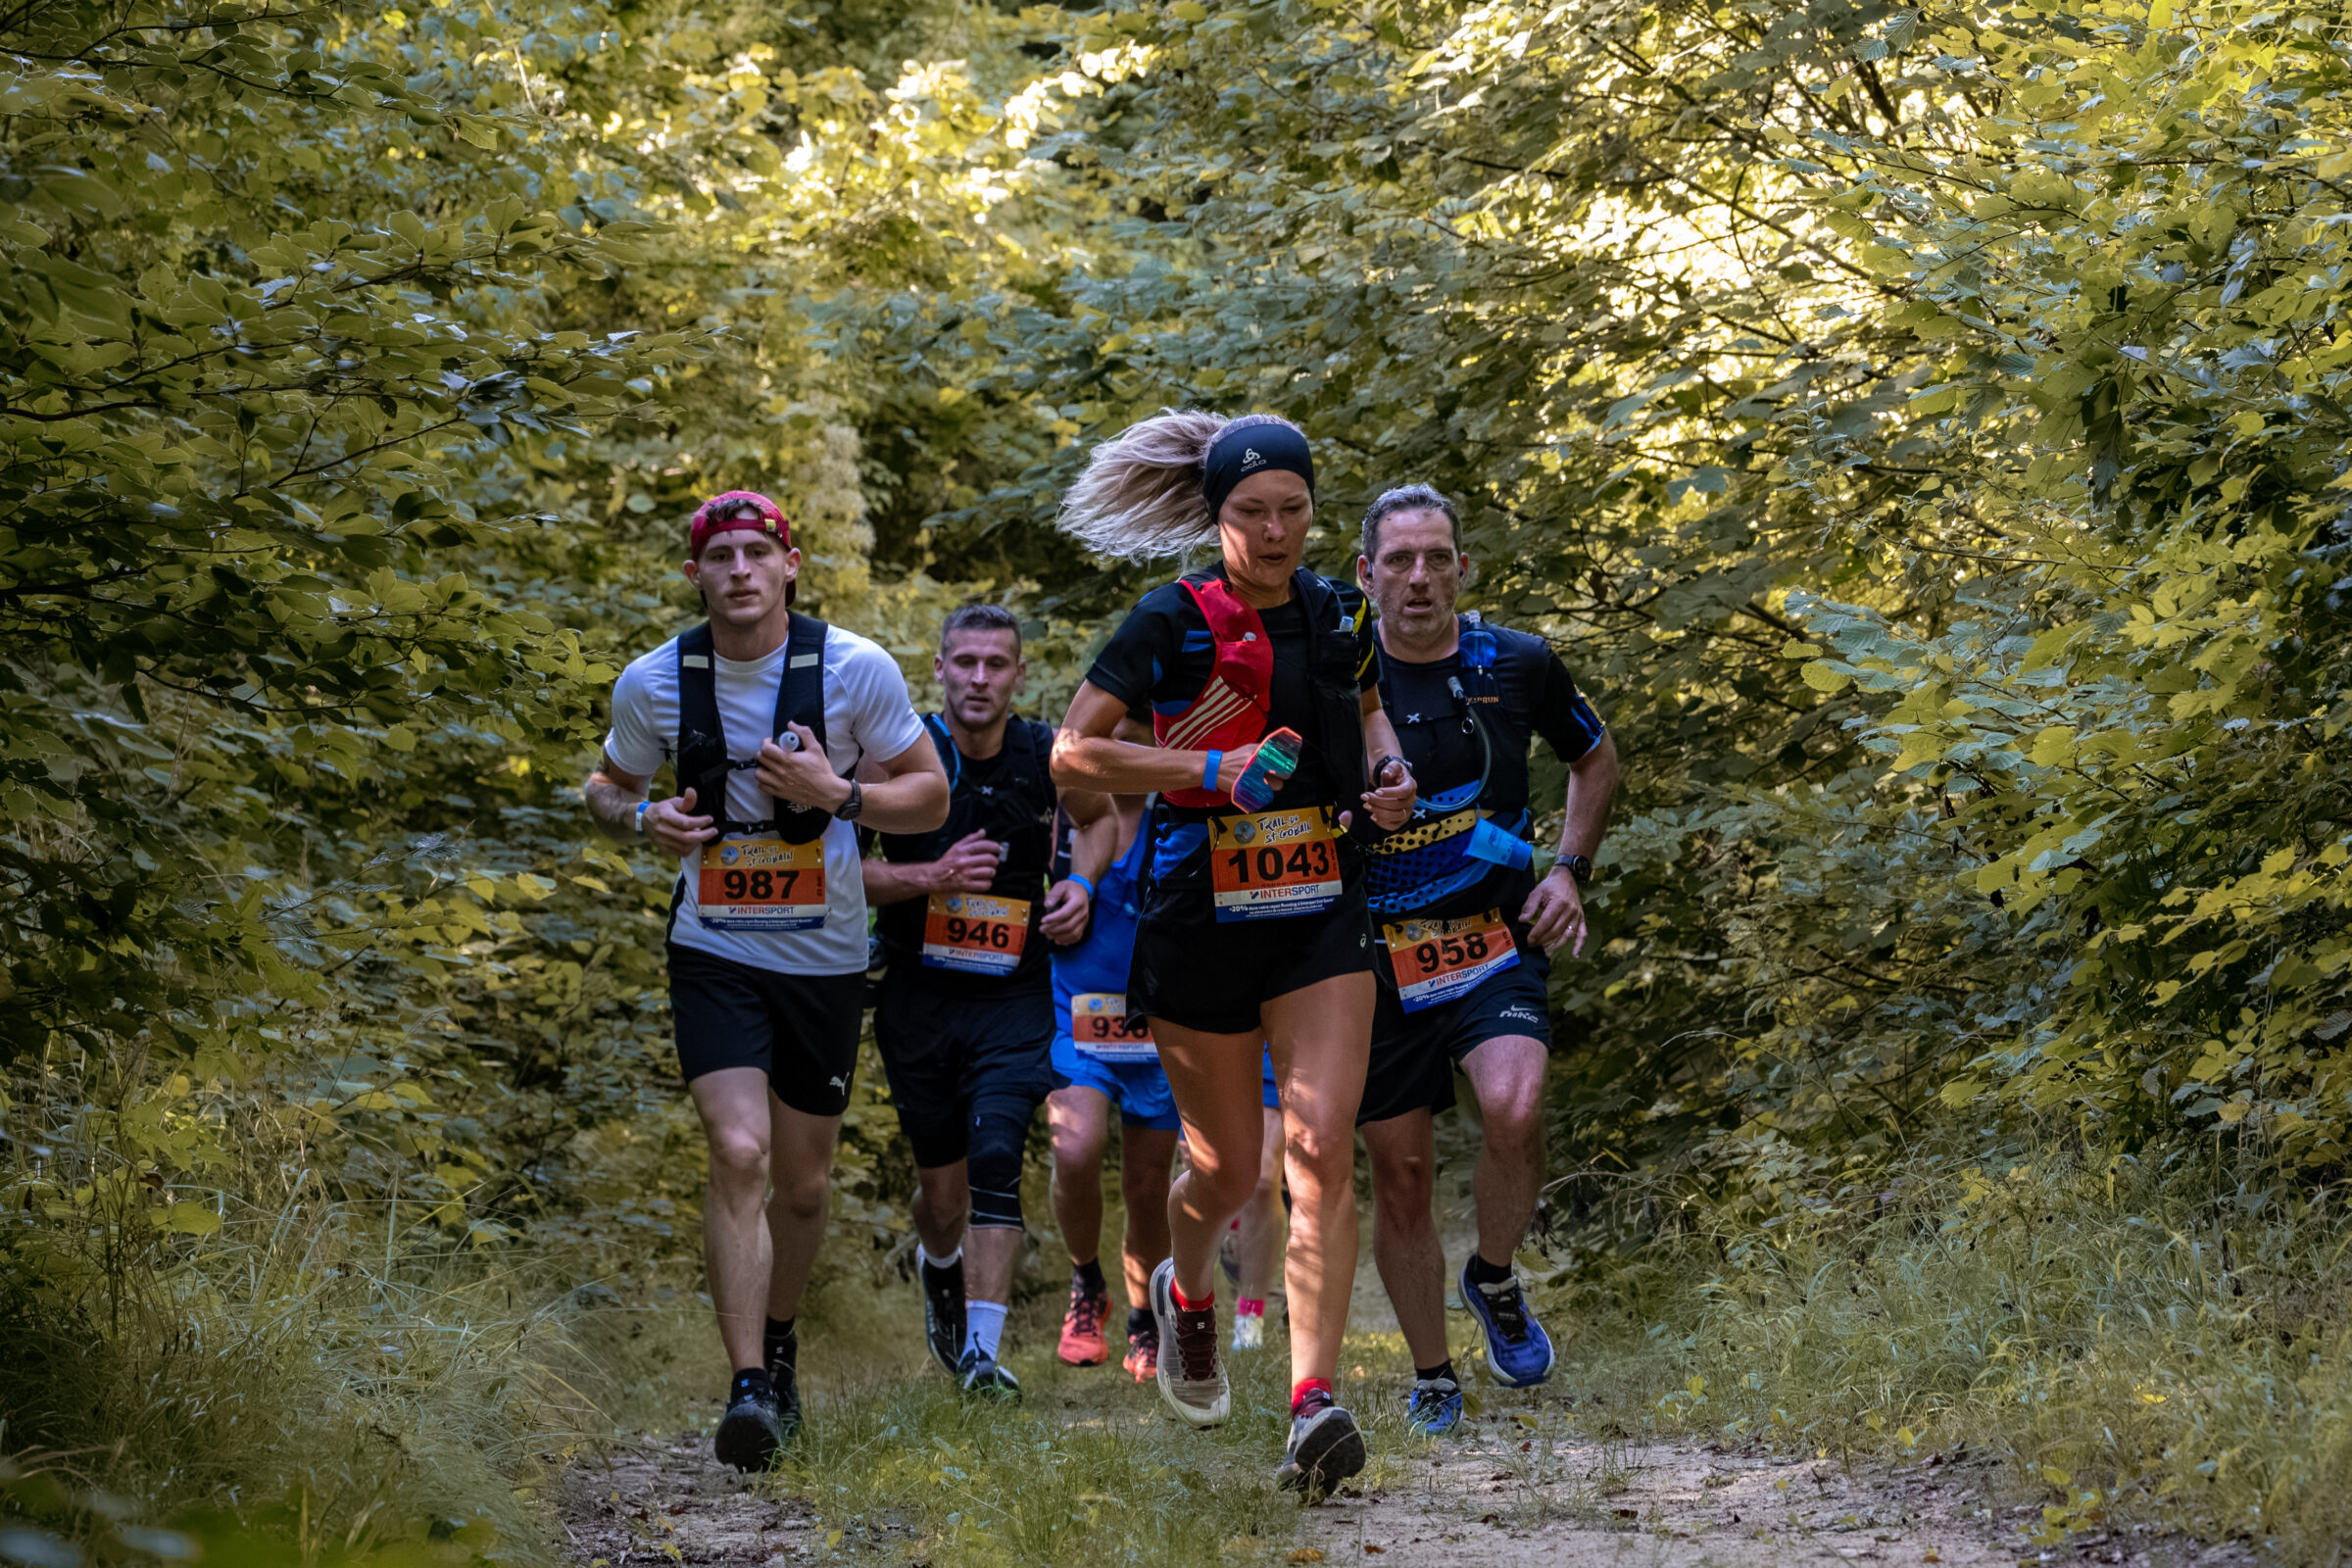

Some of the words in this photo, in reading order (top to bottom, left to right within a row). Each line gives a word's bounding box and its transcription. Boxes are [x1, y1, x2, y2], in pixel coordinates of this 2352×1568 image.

[1240, 459, 1267, 472] odlo
[1256, 816, 1288, 832] TRAIL
[1279, 821, 1312, 839] GOBAIN
[1228, 842, 1330, 883] 1043
[724, 870, 800, 899] 987
[1260, 885, 1320, 900] INTERSPORT
[737, 906, 795, 914] INTERSPORT
[947, 918, 1009, 949] 946
[1416, 932, 1489, 973] 958
[1436, 962, 1489, 986] INTERSPORT
